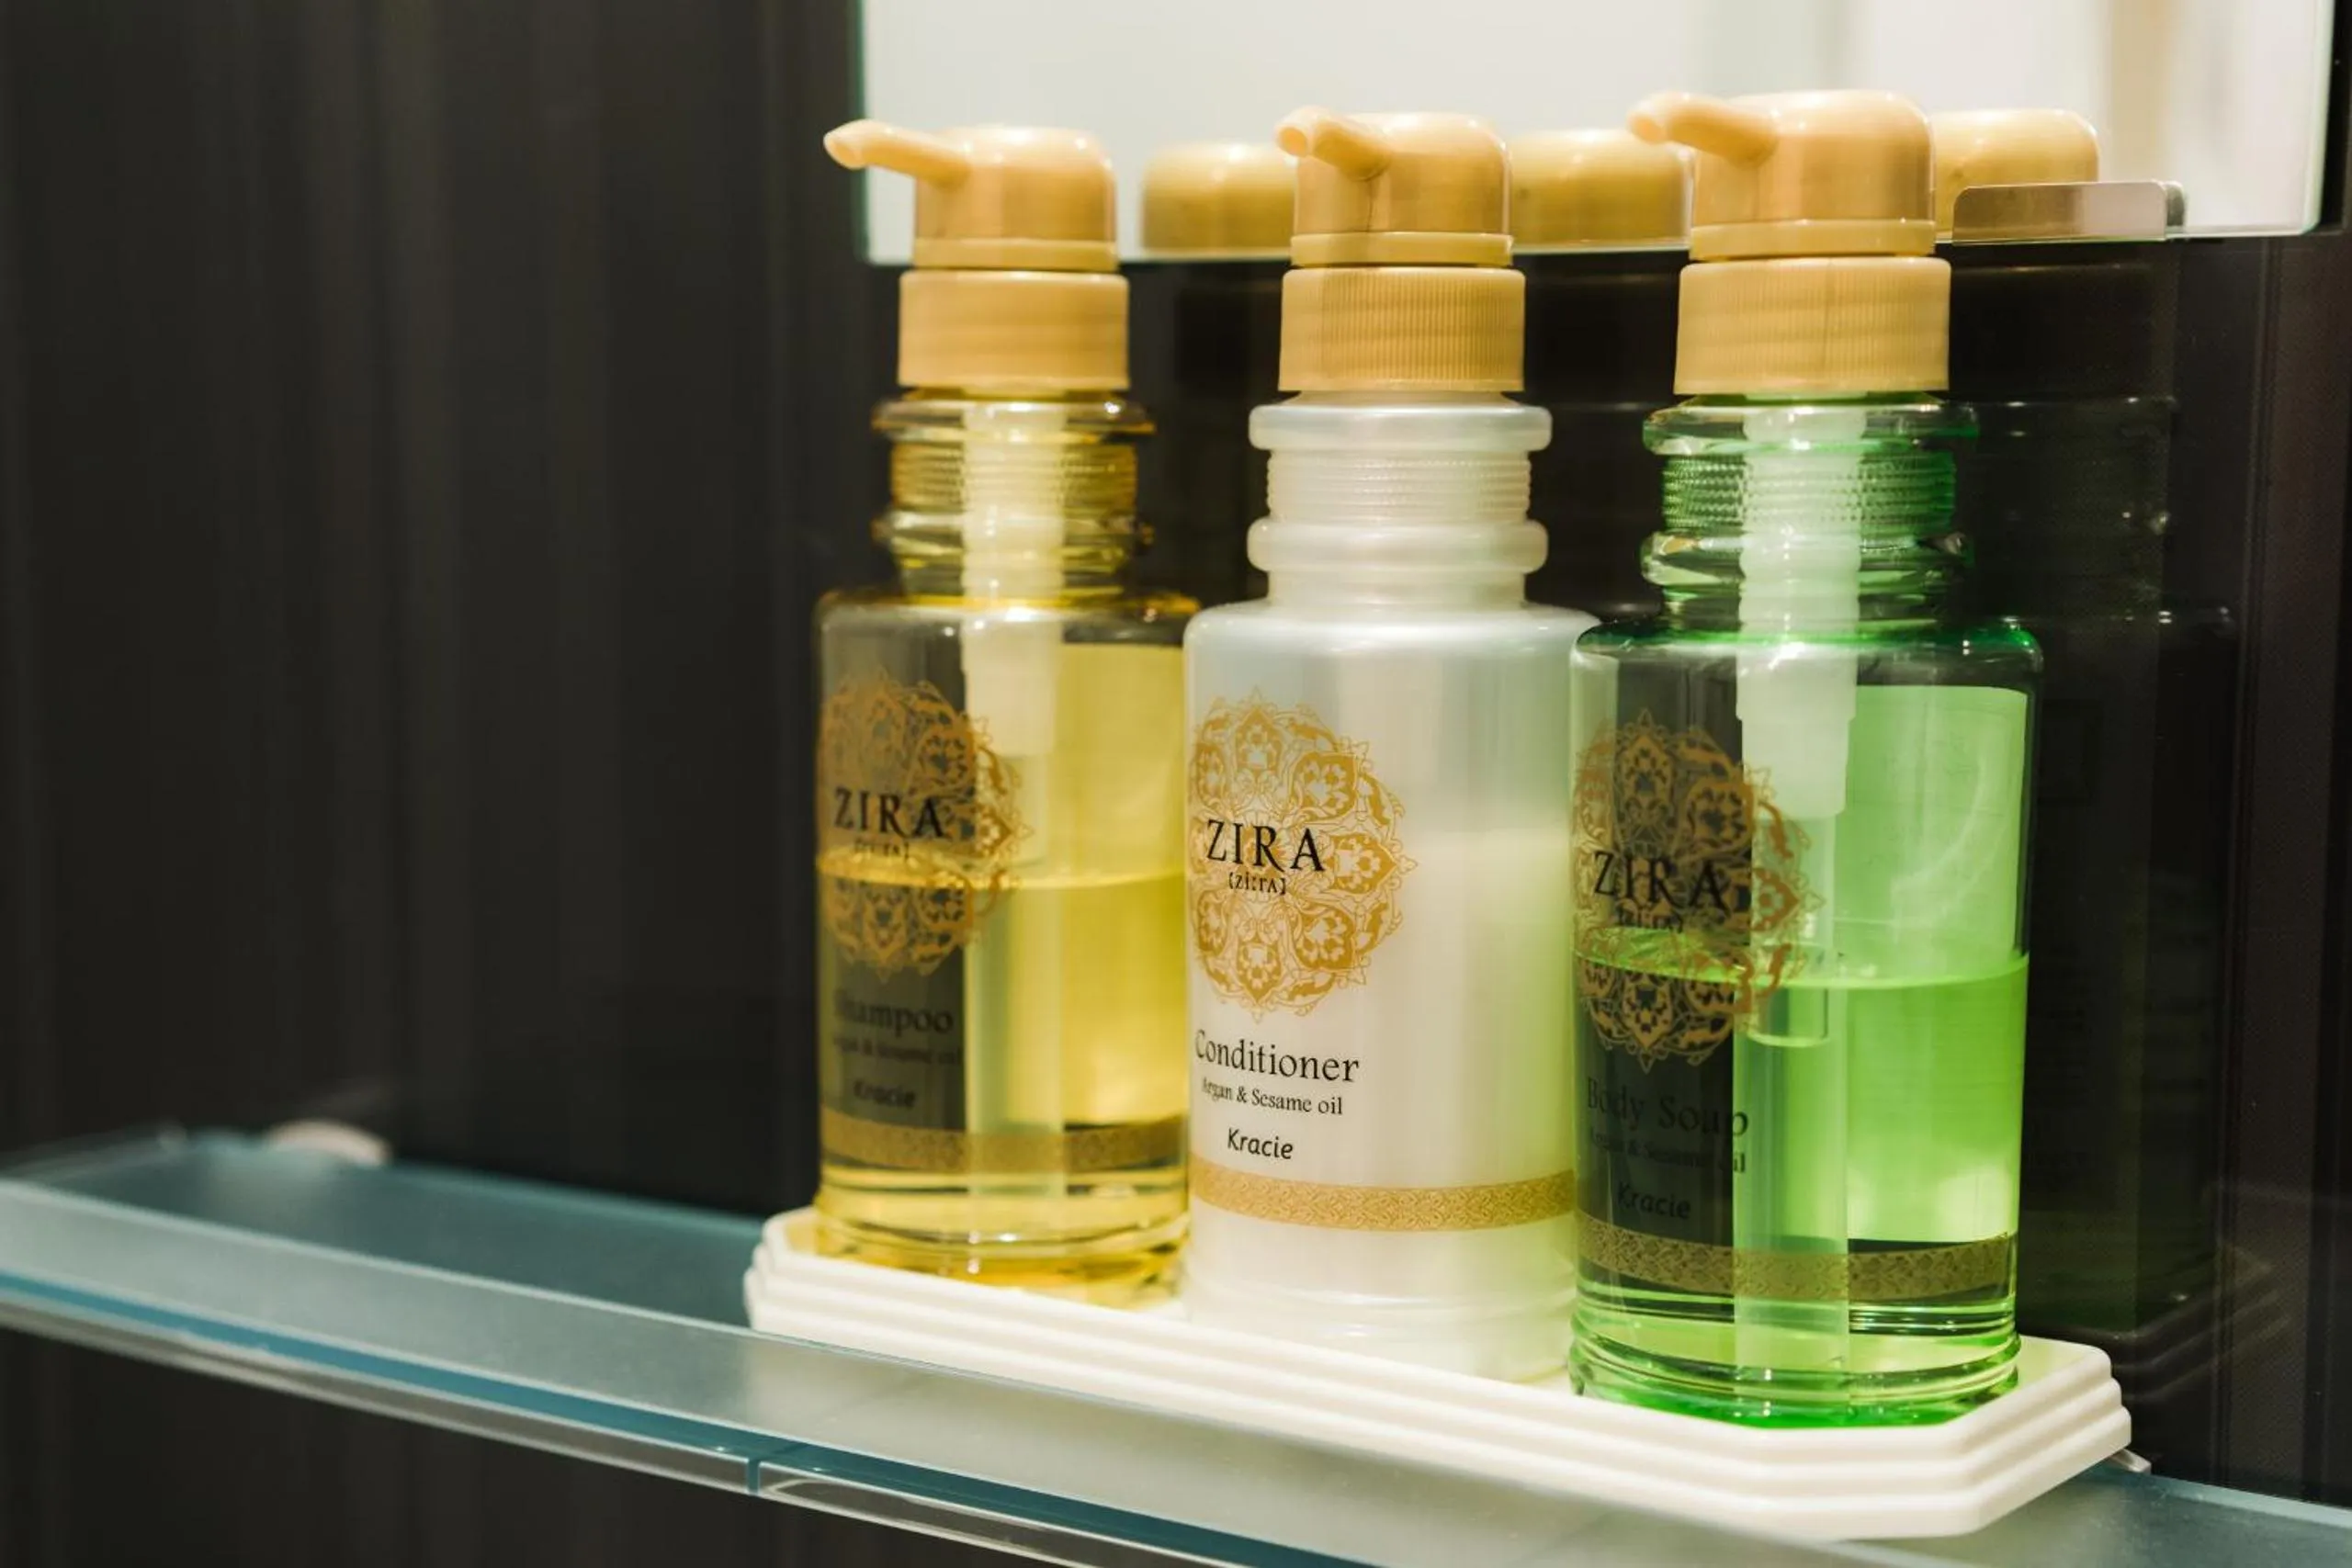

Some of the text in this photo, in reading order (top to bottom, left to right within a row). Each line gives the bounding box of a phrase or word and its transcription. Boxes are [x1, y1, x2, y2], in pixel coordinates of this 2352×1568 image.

[834, 786, 953, 840] ZIRA
[1206, 818, 1326, 873] ZIRA
[1593, 851, 1729, 913] ZIRA
[1194, 1029, 1360, 1082] Conditioner
[1201, 1076, 1343, 1115] Argan & Sesame oil
[1588, 1077, 1645, 1131] Body
[1227, 1127, 1294, 1160] Kracie
[1618, 1180, 1691, 1221] Kracie
